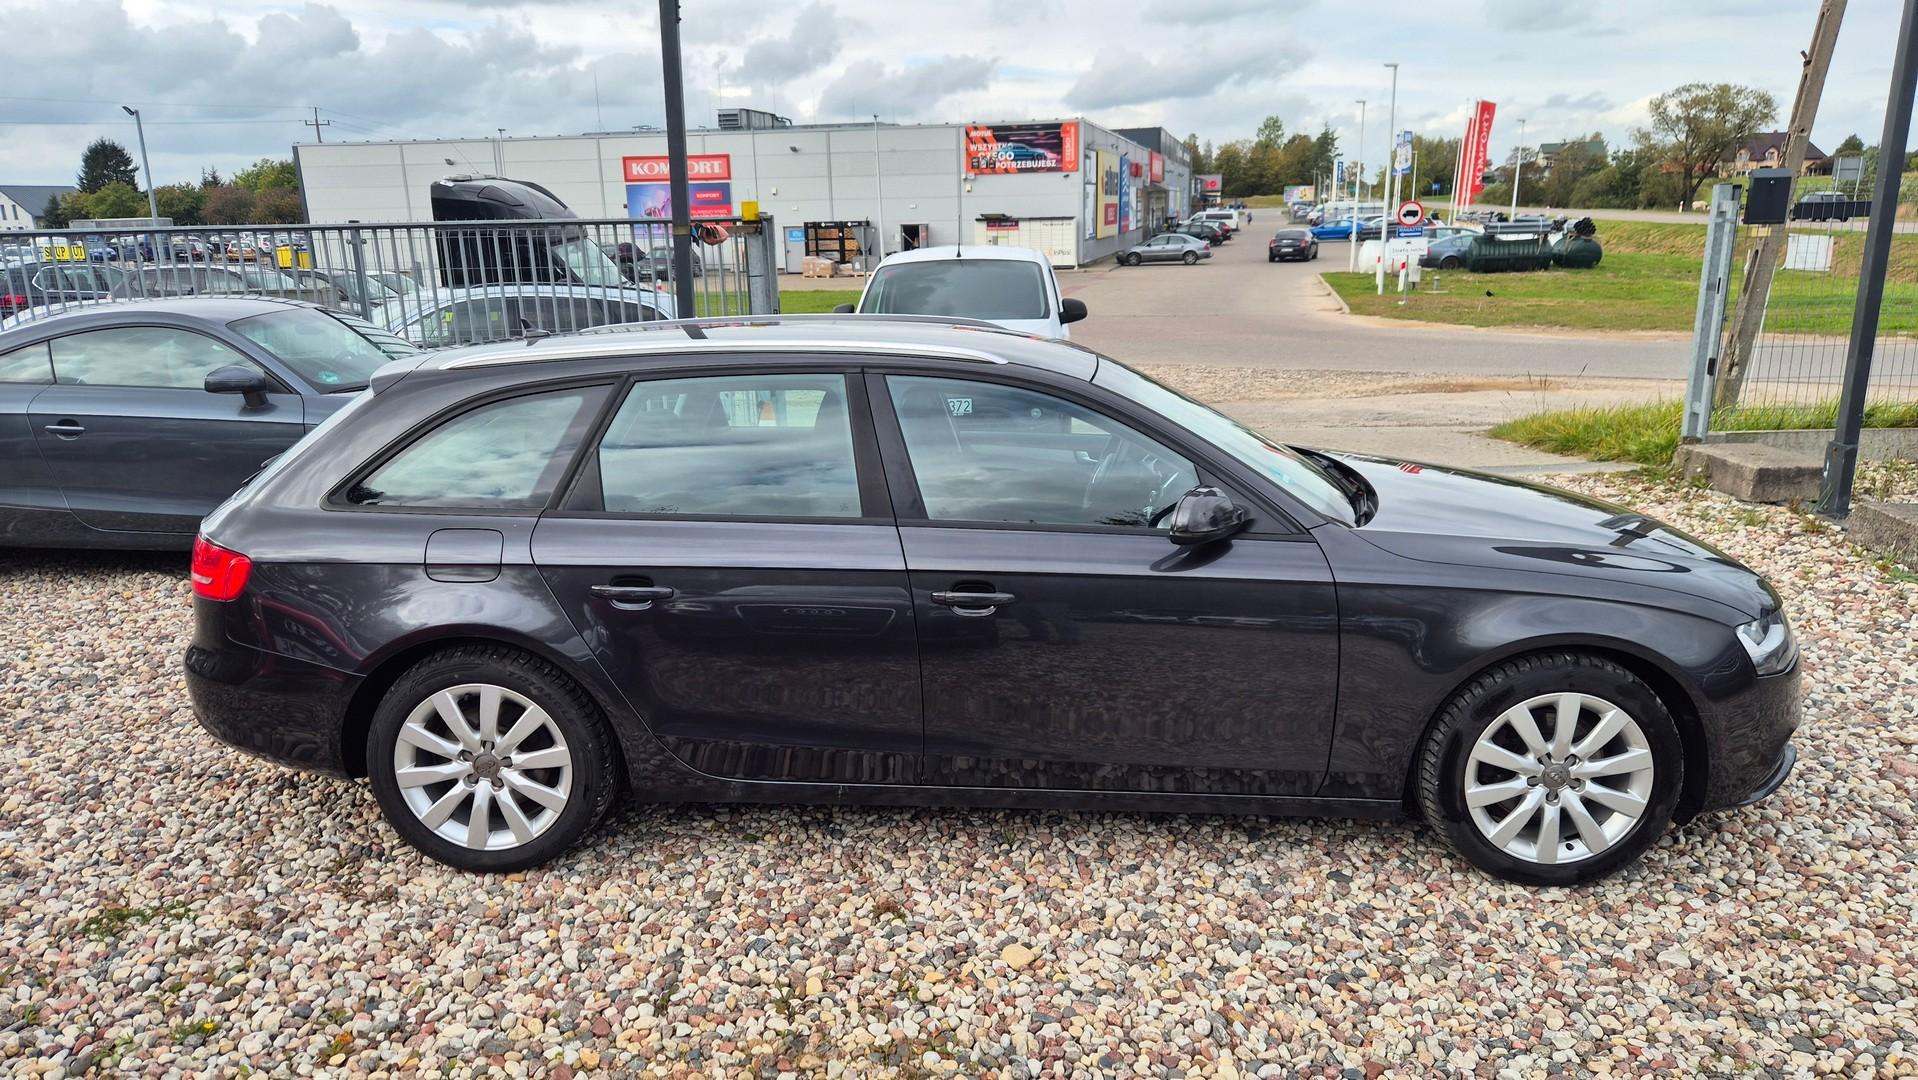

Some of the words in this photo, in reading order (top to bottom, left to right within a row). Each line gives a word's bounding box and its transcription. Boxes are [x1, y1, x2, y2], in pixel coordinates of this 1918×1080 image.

[969, 143, 1014, 151] WSZYSTKO
[631, 160, 722, 175] KOMORT
[995, 159, 1057, 169] POTRZEBUJESZ
[44, 246, 66, 258] SUP
